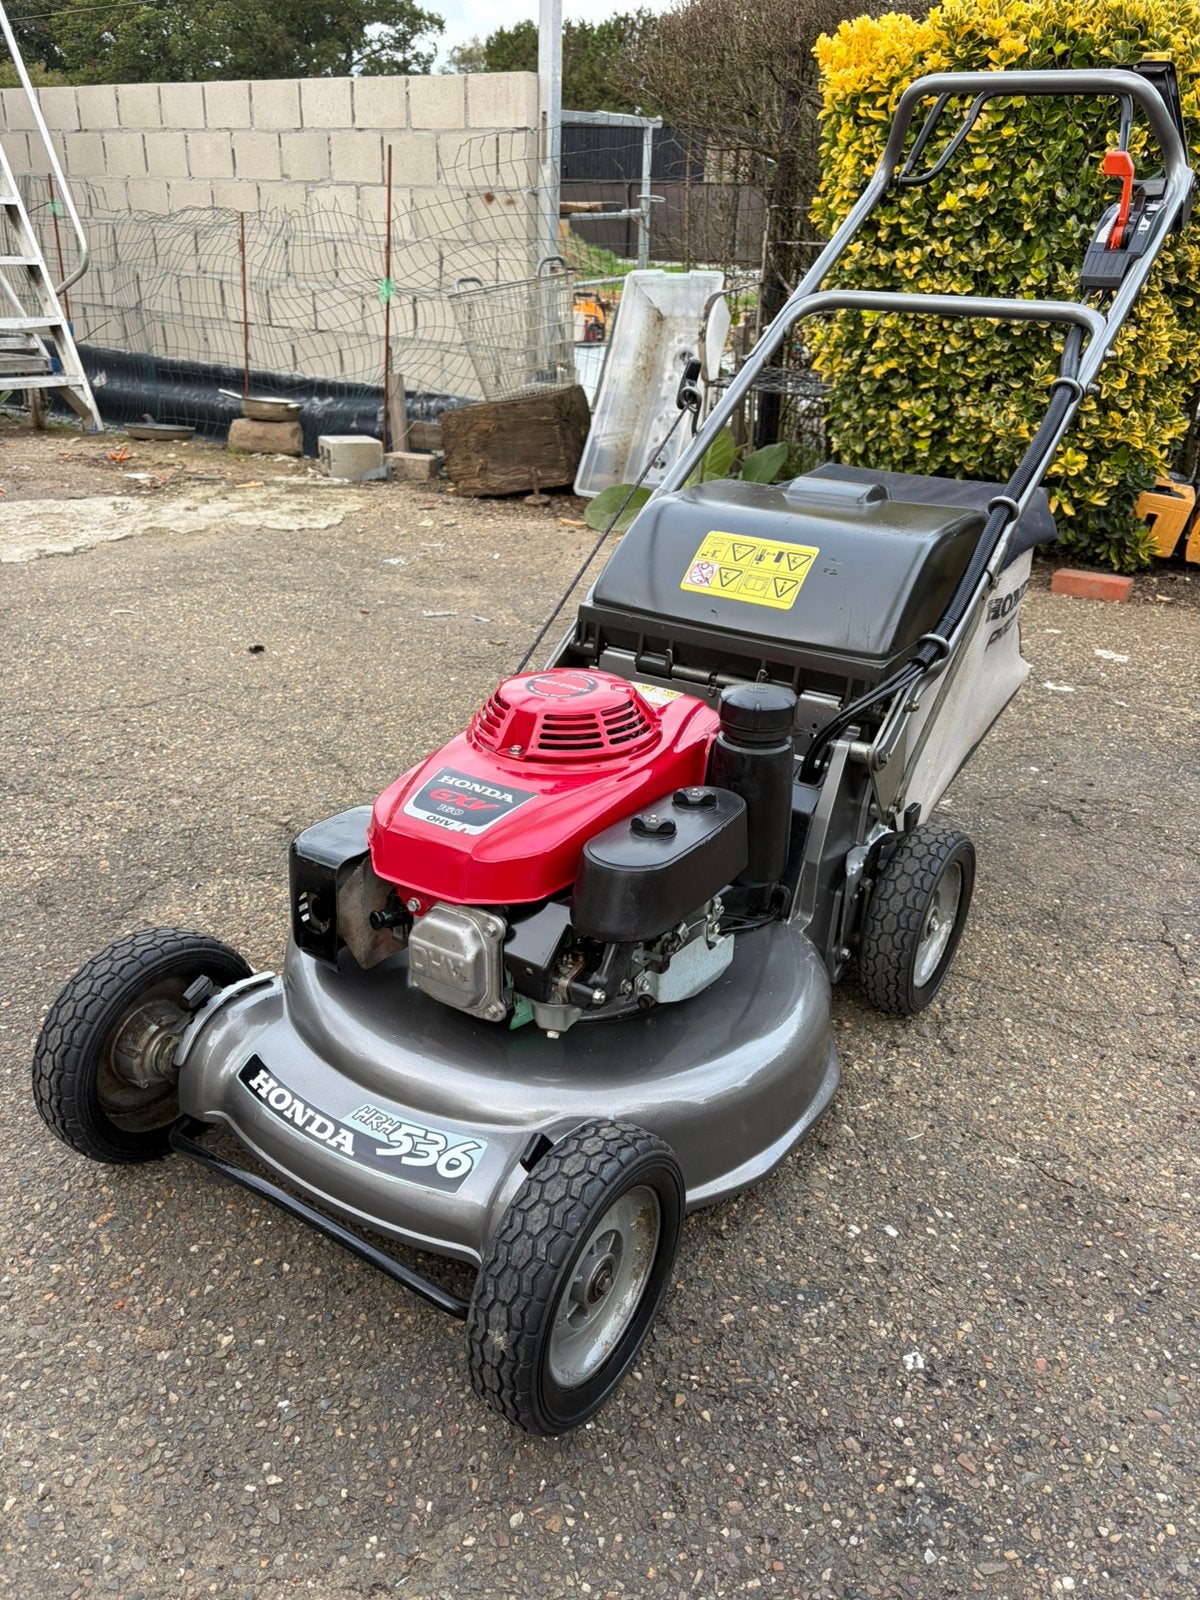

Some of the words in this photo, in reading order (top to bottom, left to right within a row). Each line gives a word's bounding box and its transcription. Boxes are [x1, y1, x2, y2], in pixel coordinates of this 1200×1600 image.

[429, 788, 500, 811] GXV
[437, 775, 513, 803] HONDA
[426, 815, 454, 826] OHV
[248, 1069, 356, 1157] HONDA
